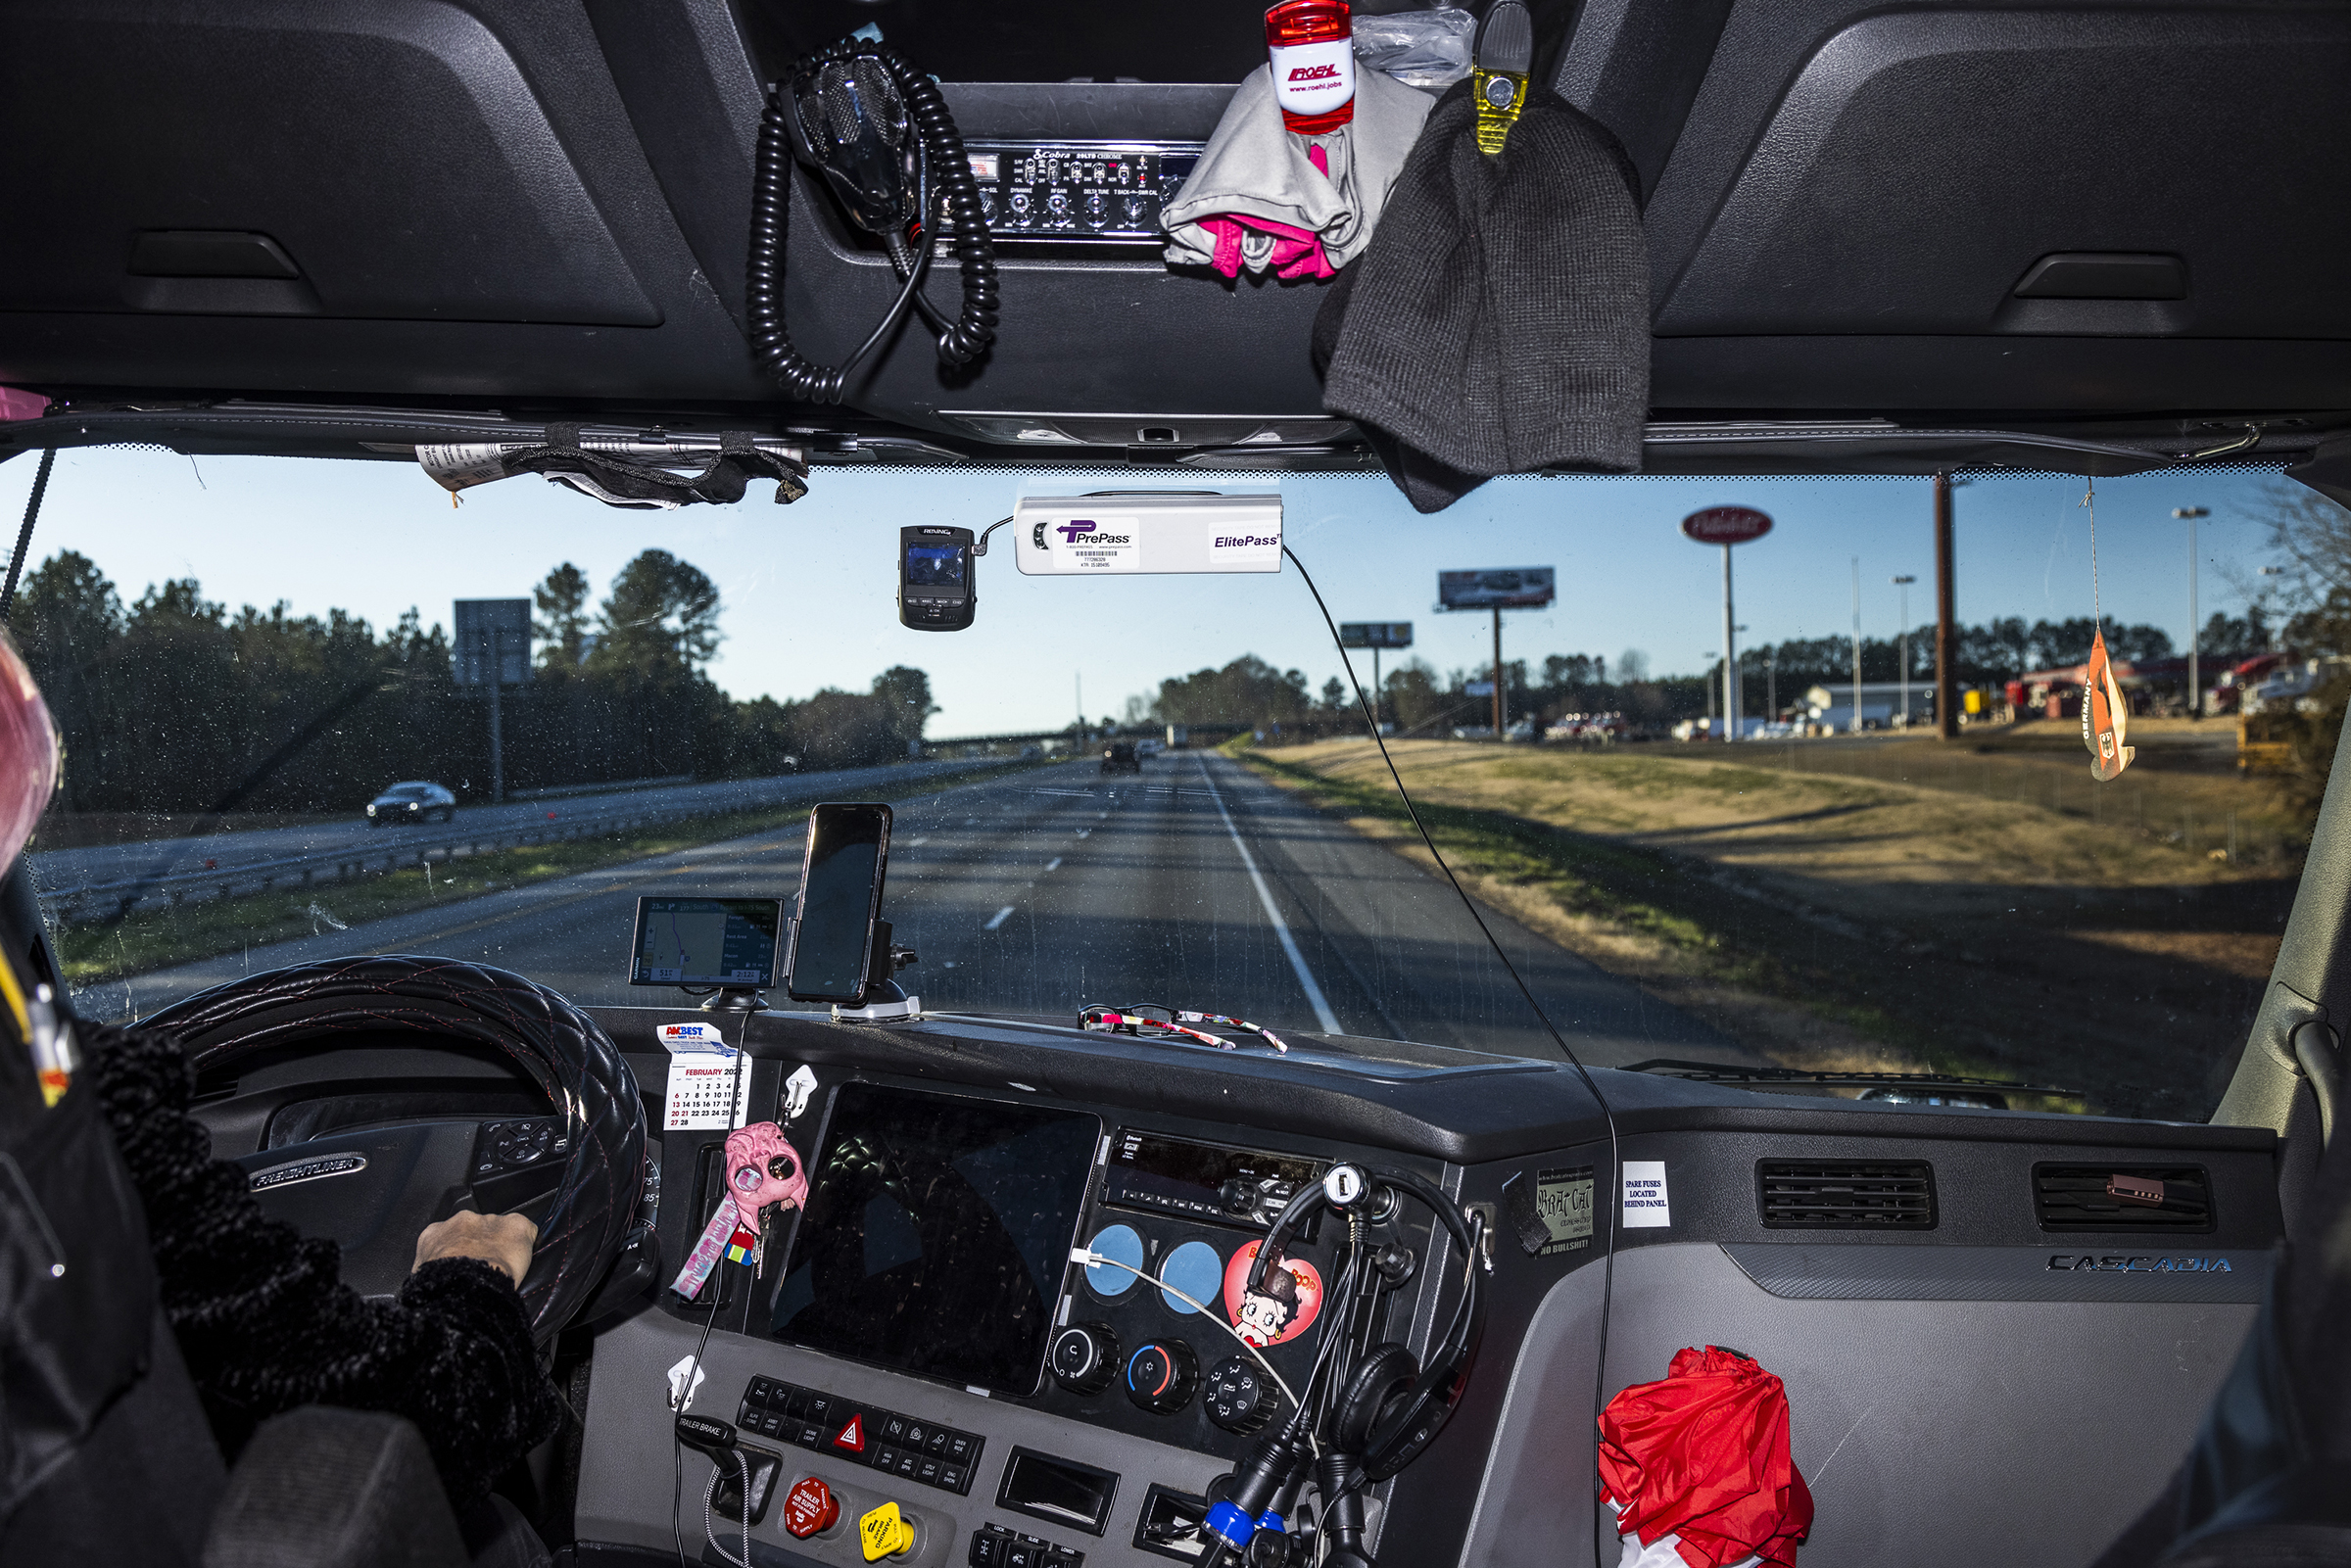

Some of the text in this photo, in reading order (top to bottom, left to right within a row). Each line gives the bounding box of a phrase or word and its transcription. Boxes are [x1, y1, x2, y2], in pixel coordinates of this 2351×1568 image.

[1288, 64, 1342, 81] ROEHL
[1289, 82, 1342, 92] www.roehl.jobs
[1077, 533, 1129, 544] PrePass
[1215, 536, 1277, 547] ElitePass
[2083, 678, 2092, 740] GERMANY
[257, 1160, 354, 1186] FREIGHTLINER
[1541, 1239, 1588, 1256] NO BULLSHIT!
[2045, 1256, 2231, 1272] CASCADIA
[1291, 1268, 1317, 1291] BOOP
[679, 1418, 721, 1436] TRAILER BRAKE
[799, 1489, 820, 1505] TRAILER
[801, 1499, 821, 1514] SUPPLY
[876, 1517, 893, 1548] PARKING
